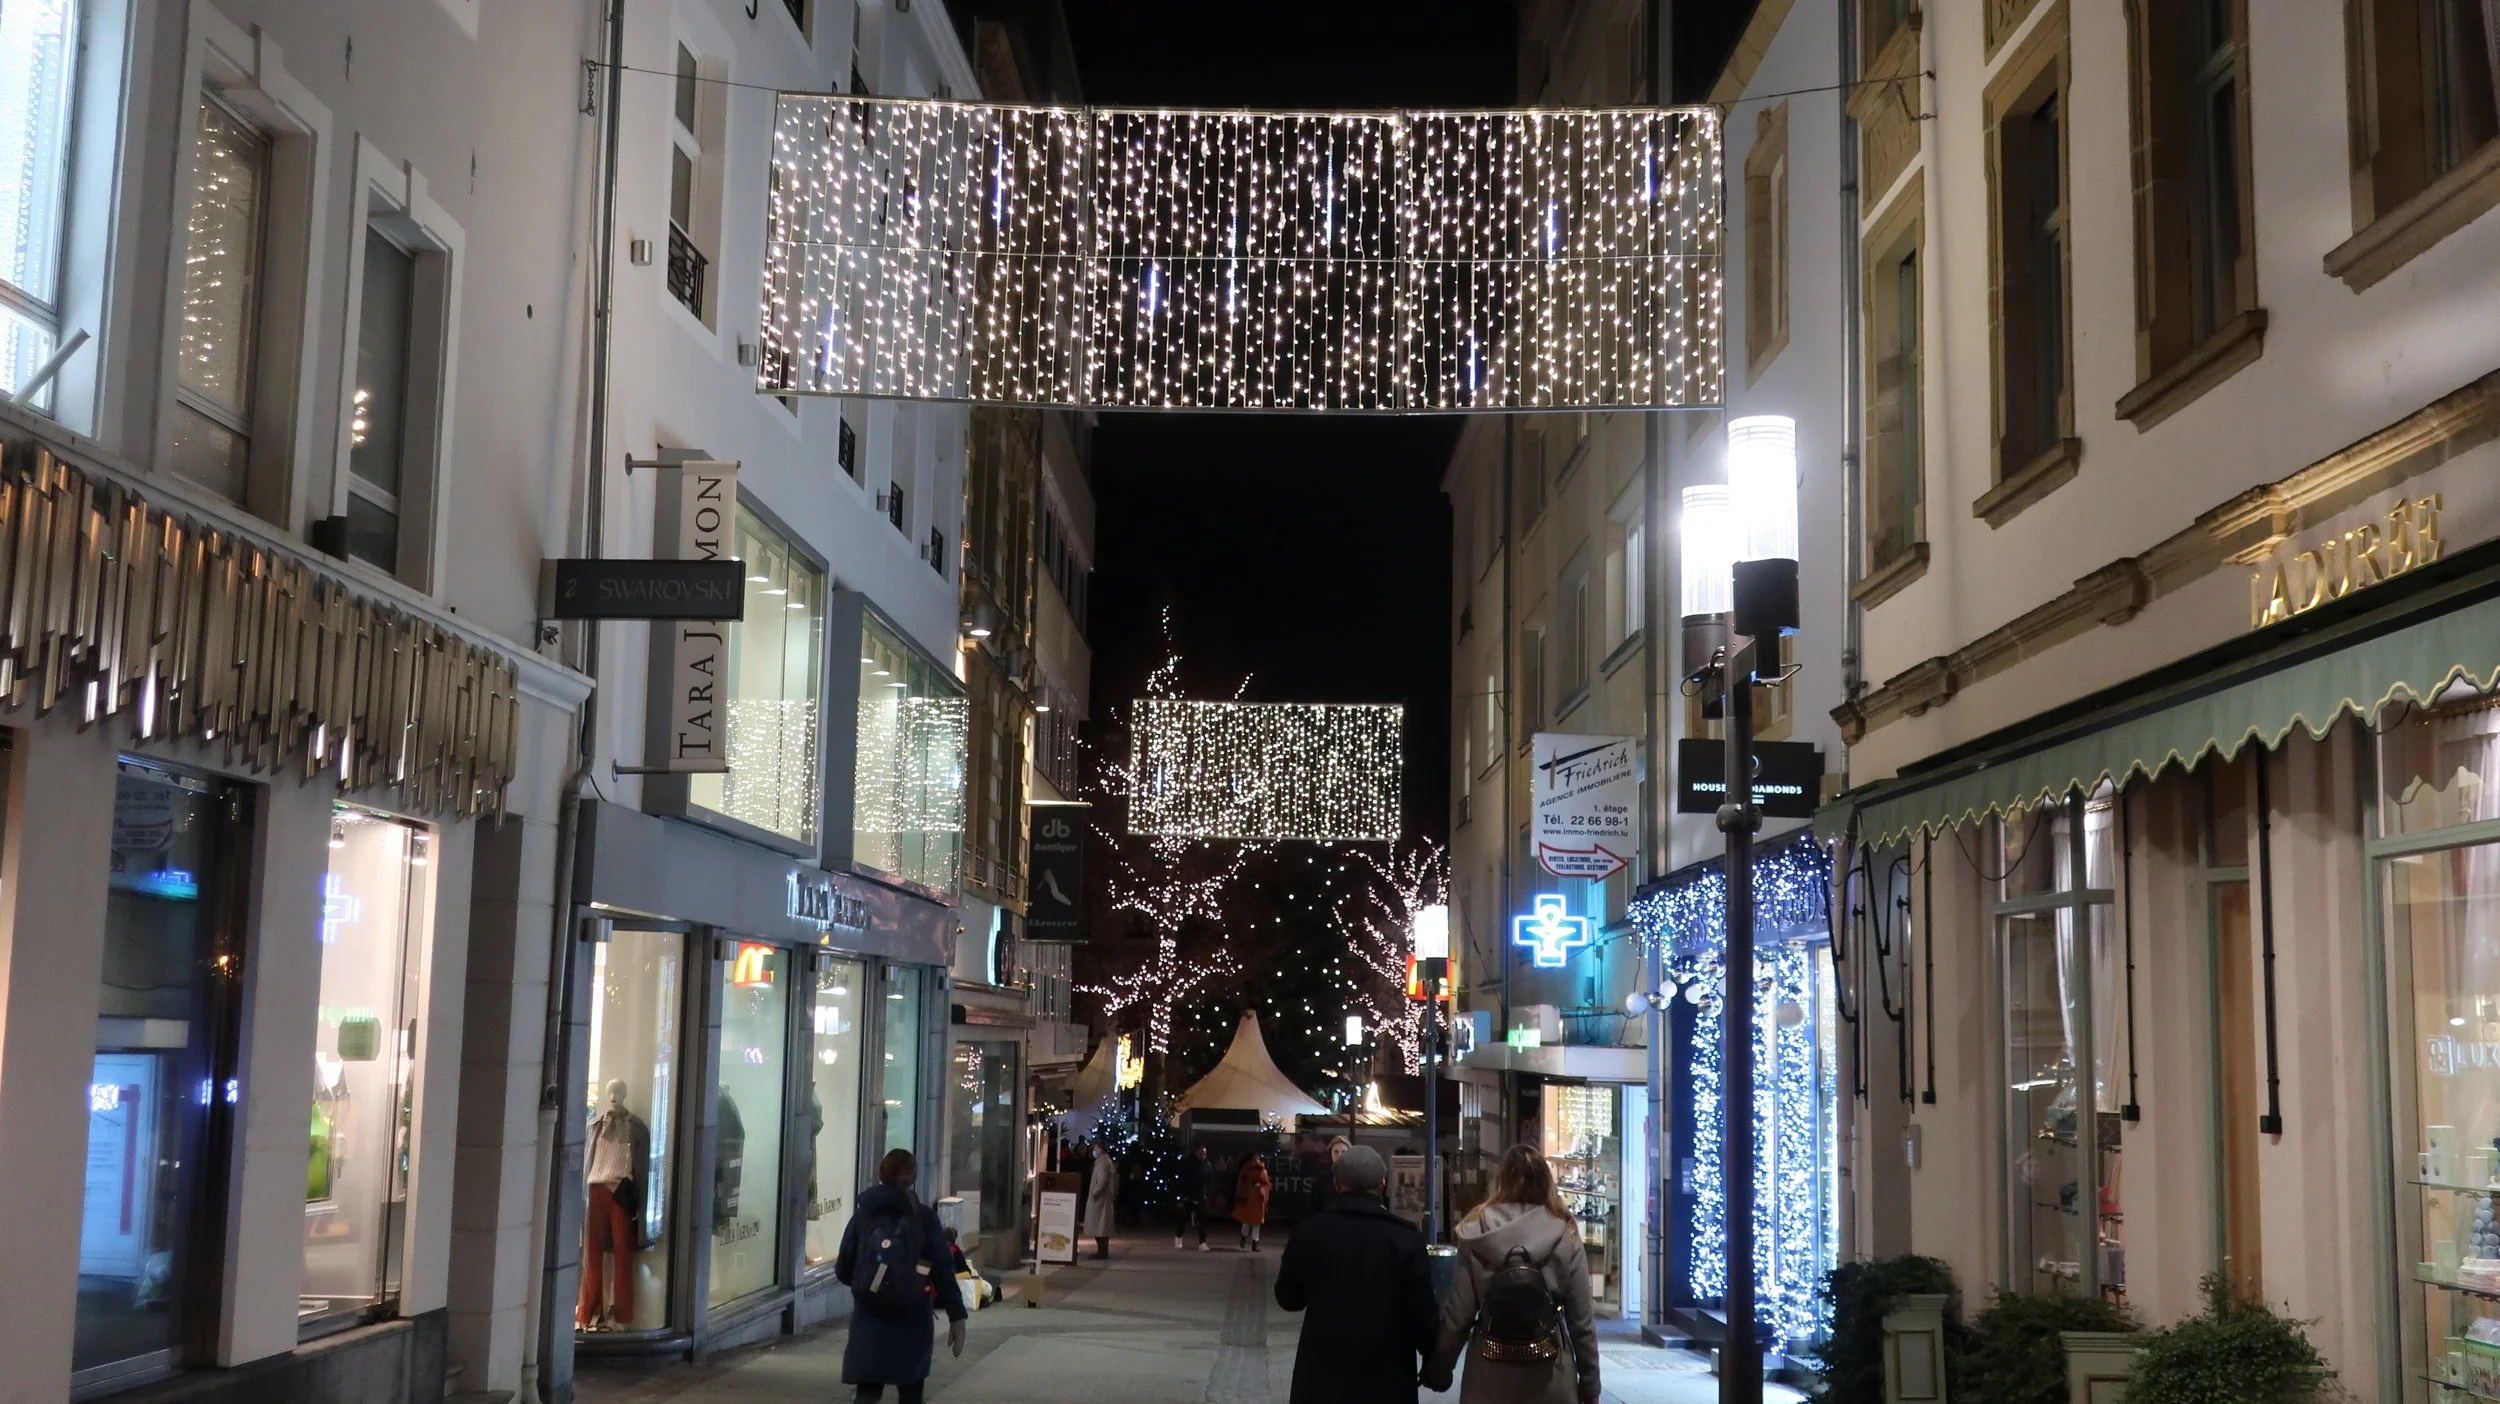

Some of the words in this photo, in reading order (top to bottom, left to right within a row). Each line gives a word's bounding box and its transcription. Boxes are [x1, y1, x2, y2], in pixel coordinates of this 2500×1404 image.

[599, 577, 732, 601] SWAROVSKI
[679, 654, 715, 758] TARA
[1557, 747, 1630, 788] Friedrich
[1692, 782, 1727, 793] HOUSE
[1540, 790, 1575, 808] AGENCE
[1603, 804, 1629, 815] étage
[1543, 814, 1564, 825] Tél.
[1570, 815, 1585, 826] 22
[1588, 816, 1602, 826] 66
[1605, 817, 1629, 827] 98-1
[1543, 828, 1629, 837] www.immo-friedrich.lu
